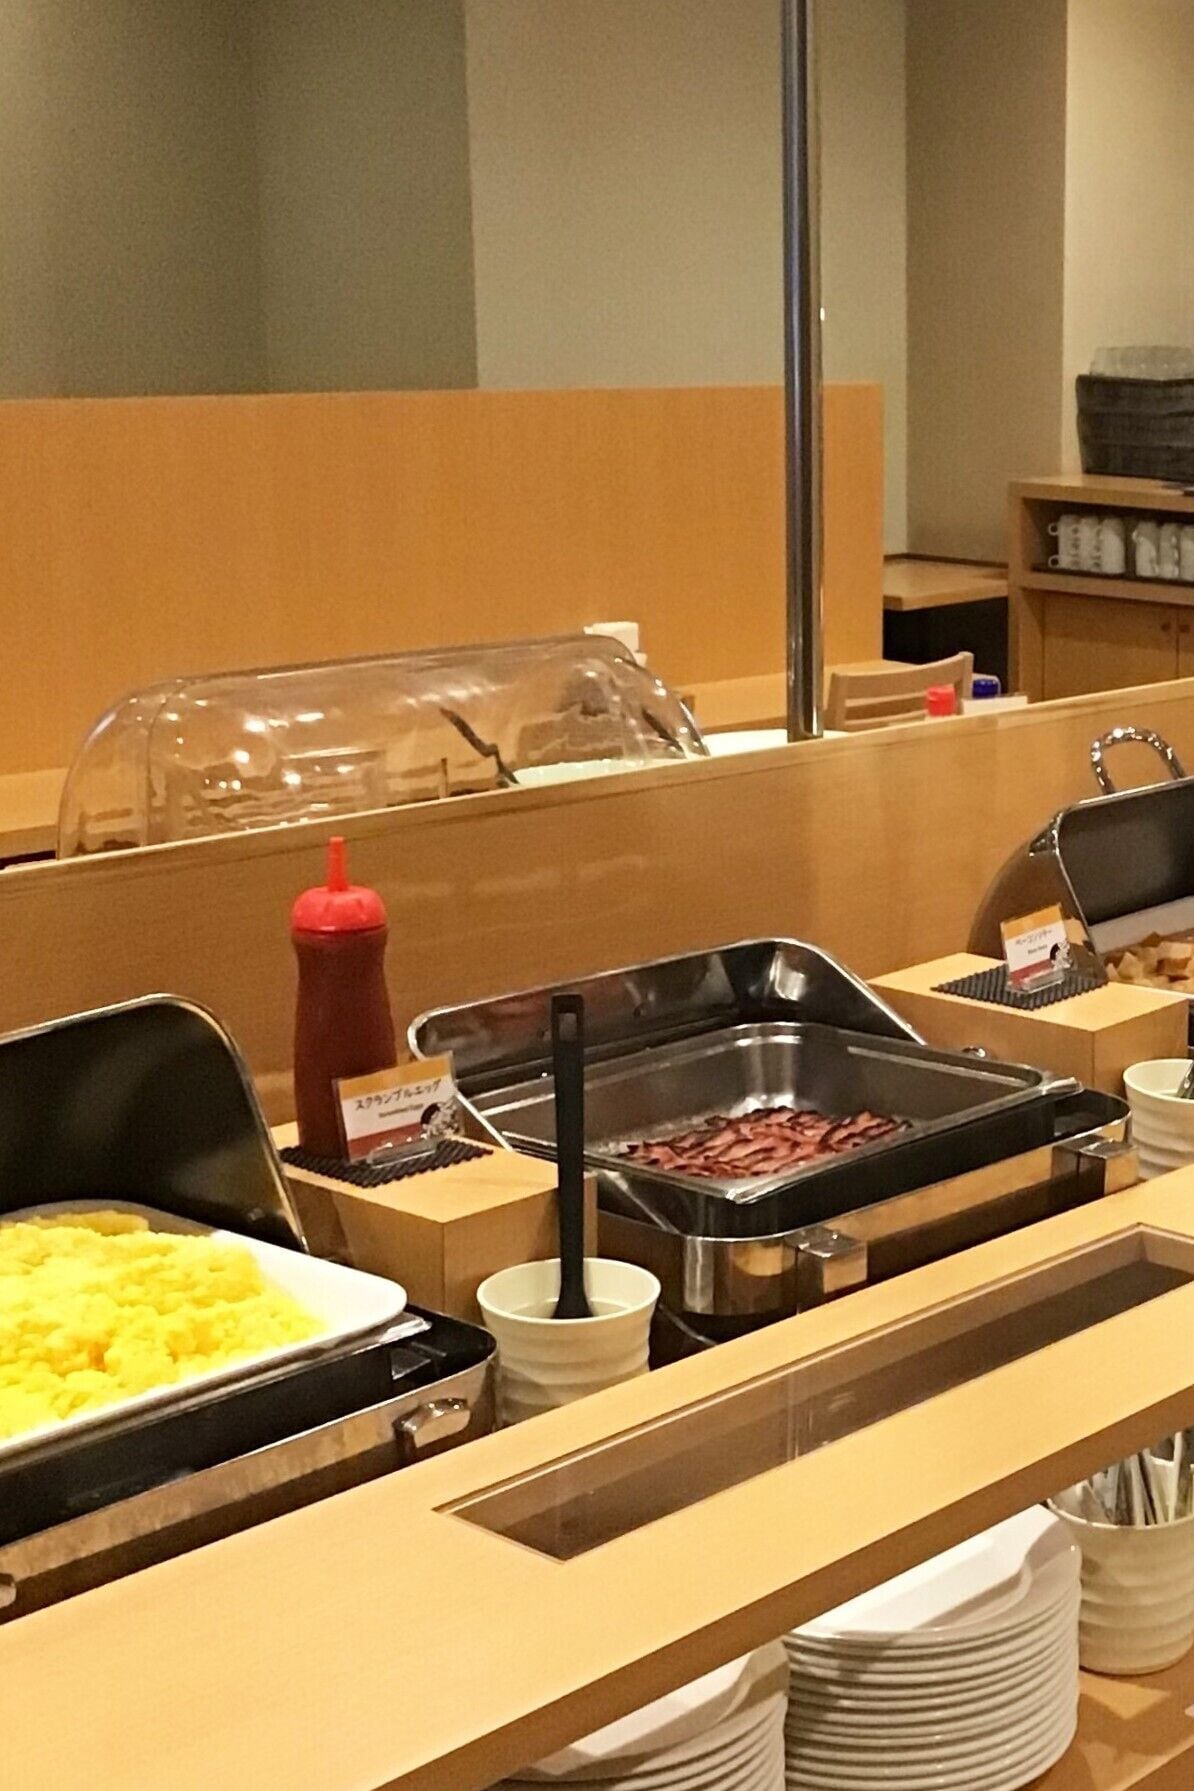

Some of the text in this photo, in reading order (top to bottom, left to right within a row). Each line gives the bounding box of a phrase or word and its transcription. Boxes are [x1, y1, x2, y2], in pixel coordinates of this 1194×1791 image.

[354, 1077, 442, 1111] スクランブルエッグ
